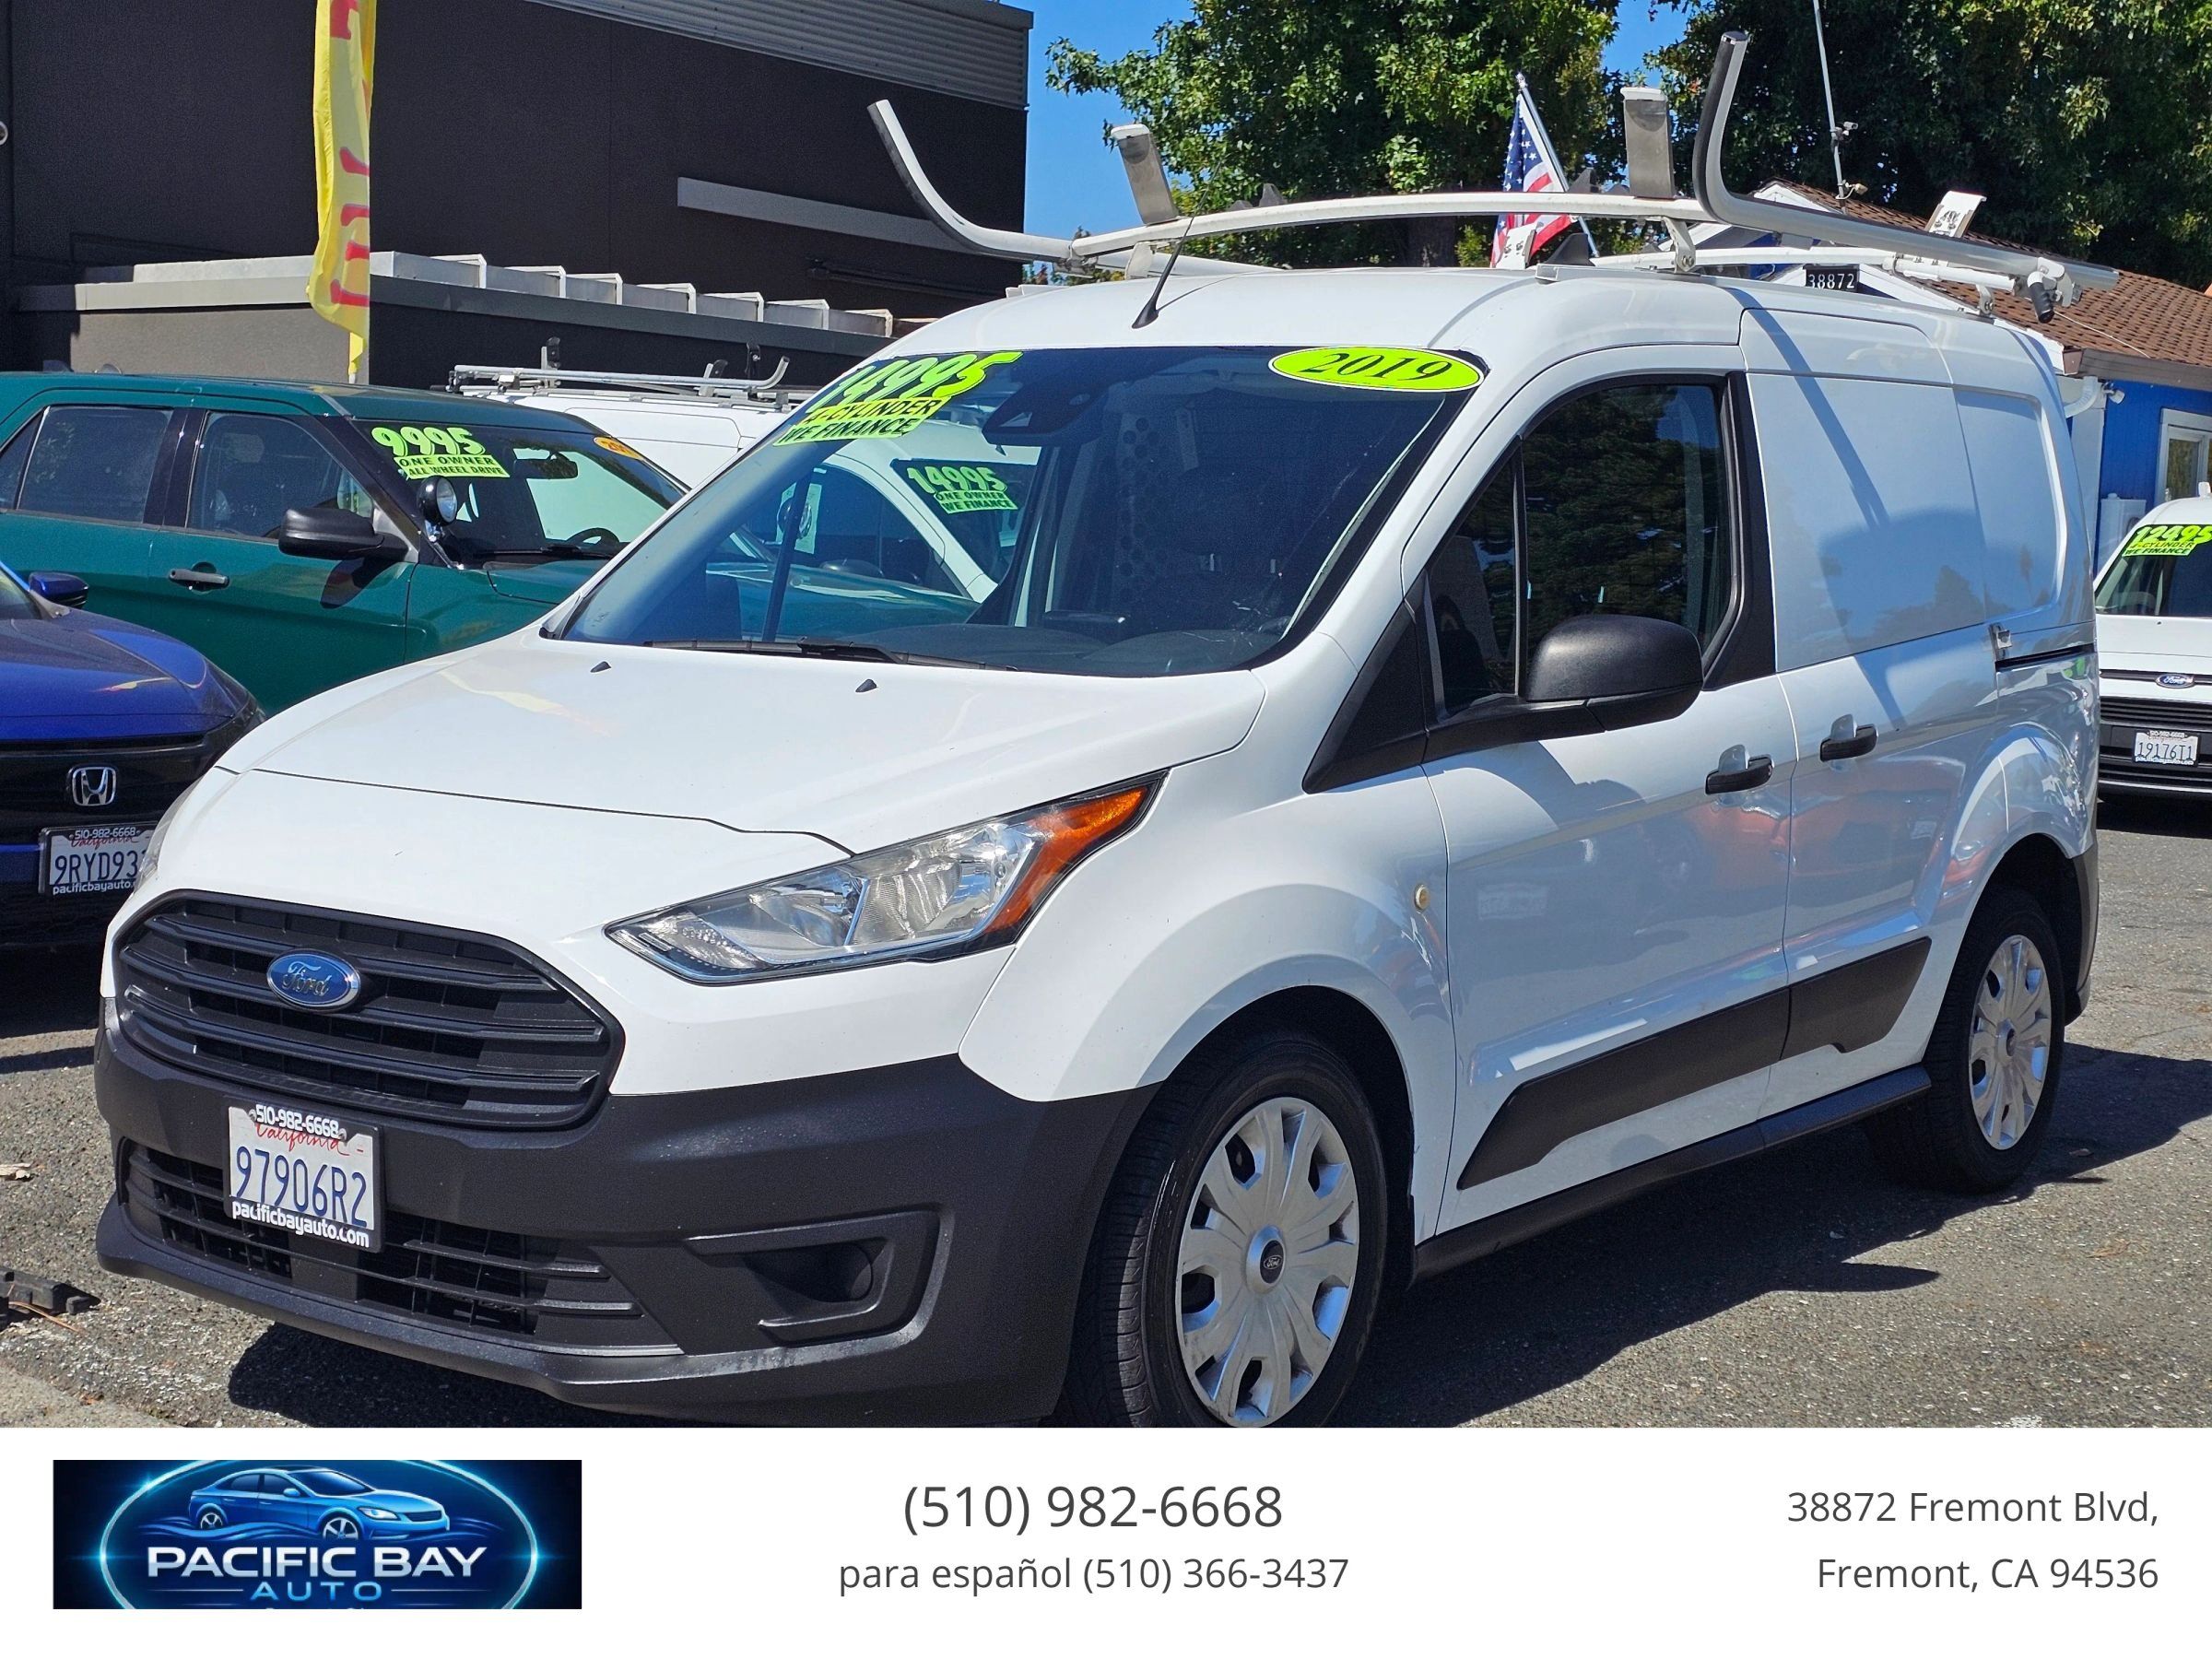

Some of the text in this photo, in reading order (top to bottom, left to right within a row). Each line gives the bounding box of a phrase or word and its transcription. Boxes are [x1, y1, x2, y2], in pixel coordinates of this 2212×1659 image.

[1808, 274, 1854, 289] 38872
[1297, 352, 1453, 382] 2019
[806, 351, 1024, 413] 14995
[371, 427, 486, 456] 9995
[810, 418, 920, 437] FINANCE
[399, 456, 495, 467] ONE OWNER
[408, 465, 504, 477] ALL WHEEL DRIVE
[907, 466, 1007, 494] 14995
[935, 491, 962, 501] ONE
[941, 500, 1015, 512] WE FINANCE
[2134, 525, 2212, 546] 12495
[74, 827, 136, 840] 510-982-6668
[54, 849, 147, 885] 9RYD93
[281, 960, 333, 996] Ford
[255, 1104, 340, 1138] 510-982-6668
[236, 1146, 368, 1228] 97906R2
[232, 1201, 370, 1248] pacificbayauto.com
